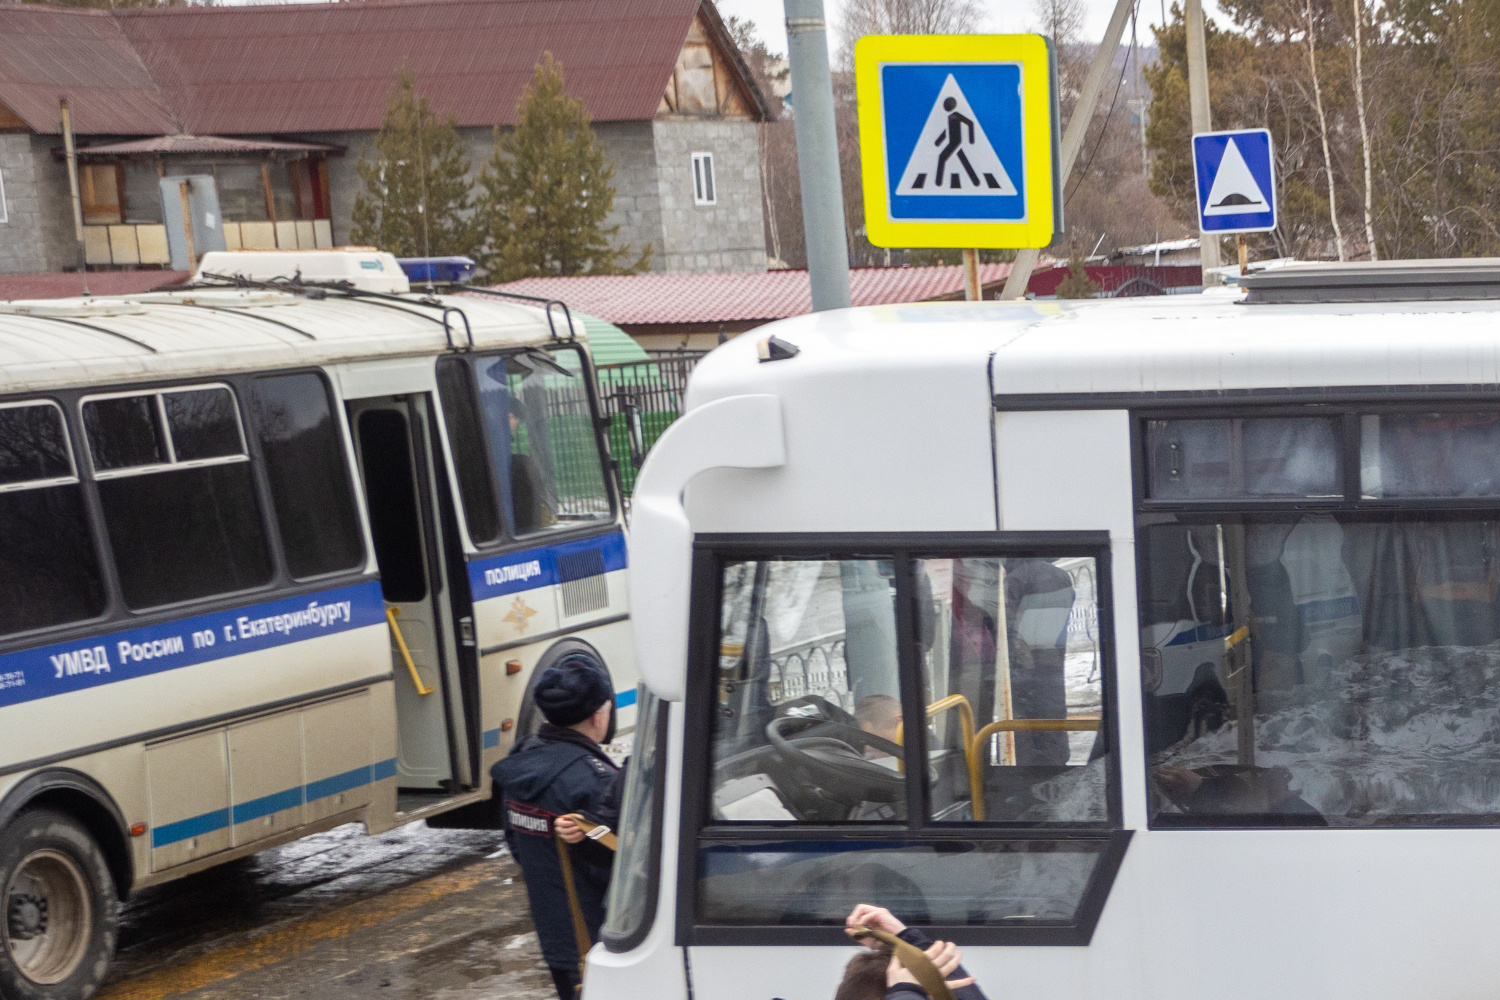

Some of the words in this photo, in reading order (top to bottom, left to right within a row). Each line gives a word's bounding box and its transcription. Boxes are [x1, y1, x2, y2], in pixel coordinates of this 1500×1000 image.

[484, 559, 541, 586] ПОЛИЦИЯ
[50, 645, 111, 679] УМВД
[117, 635, 184, 665] России
[192, 628, 216, 649] по
[223, 624, 237, 642] г.
[236, 600, 351, 639] Екатеринбургу
